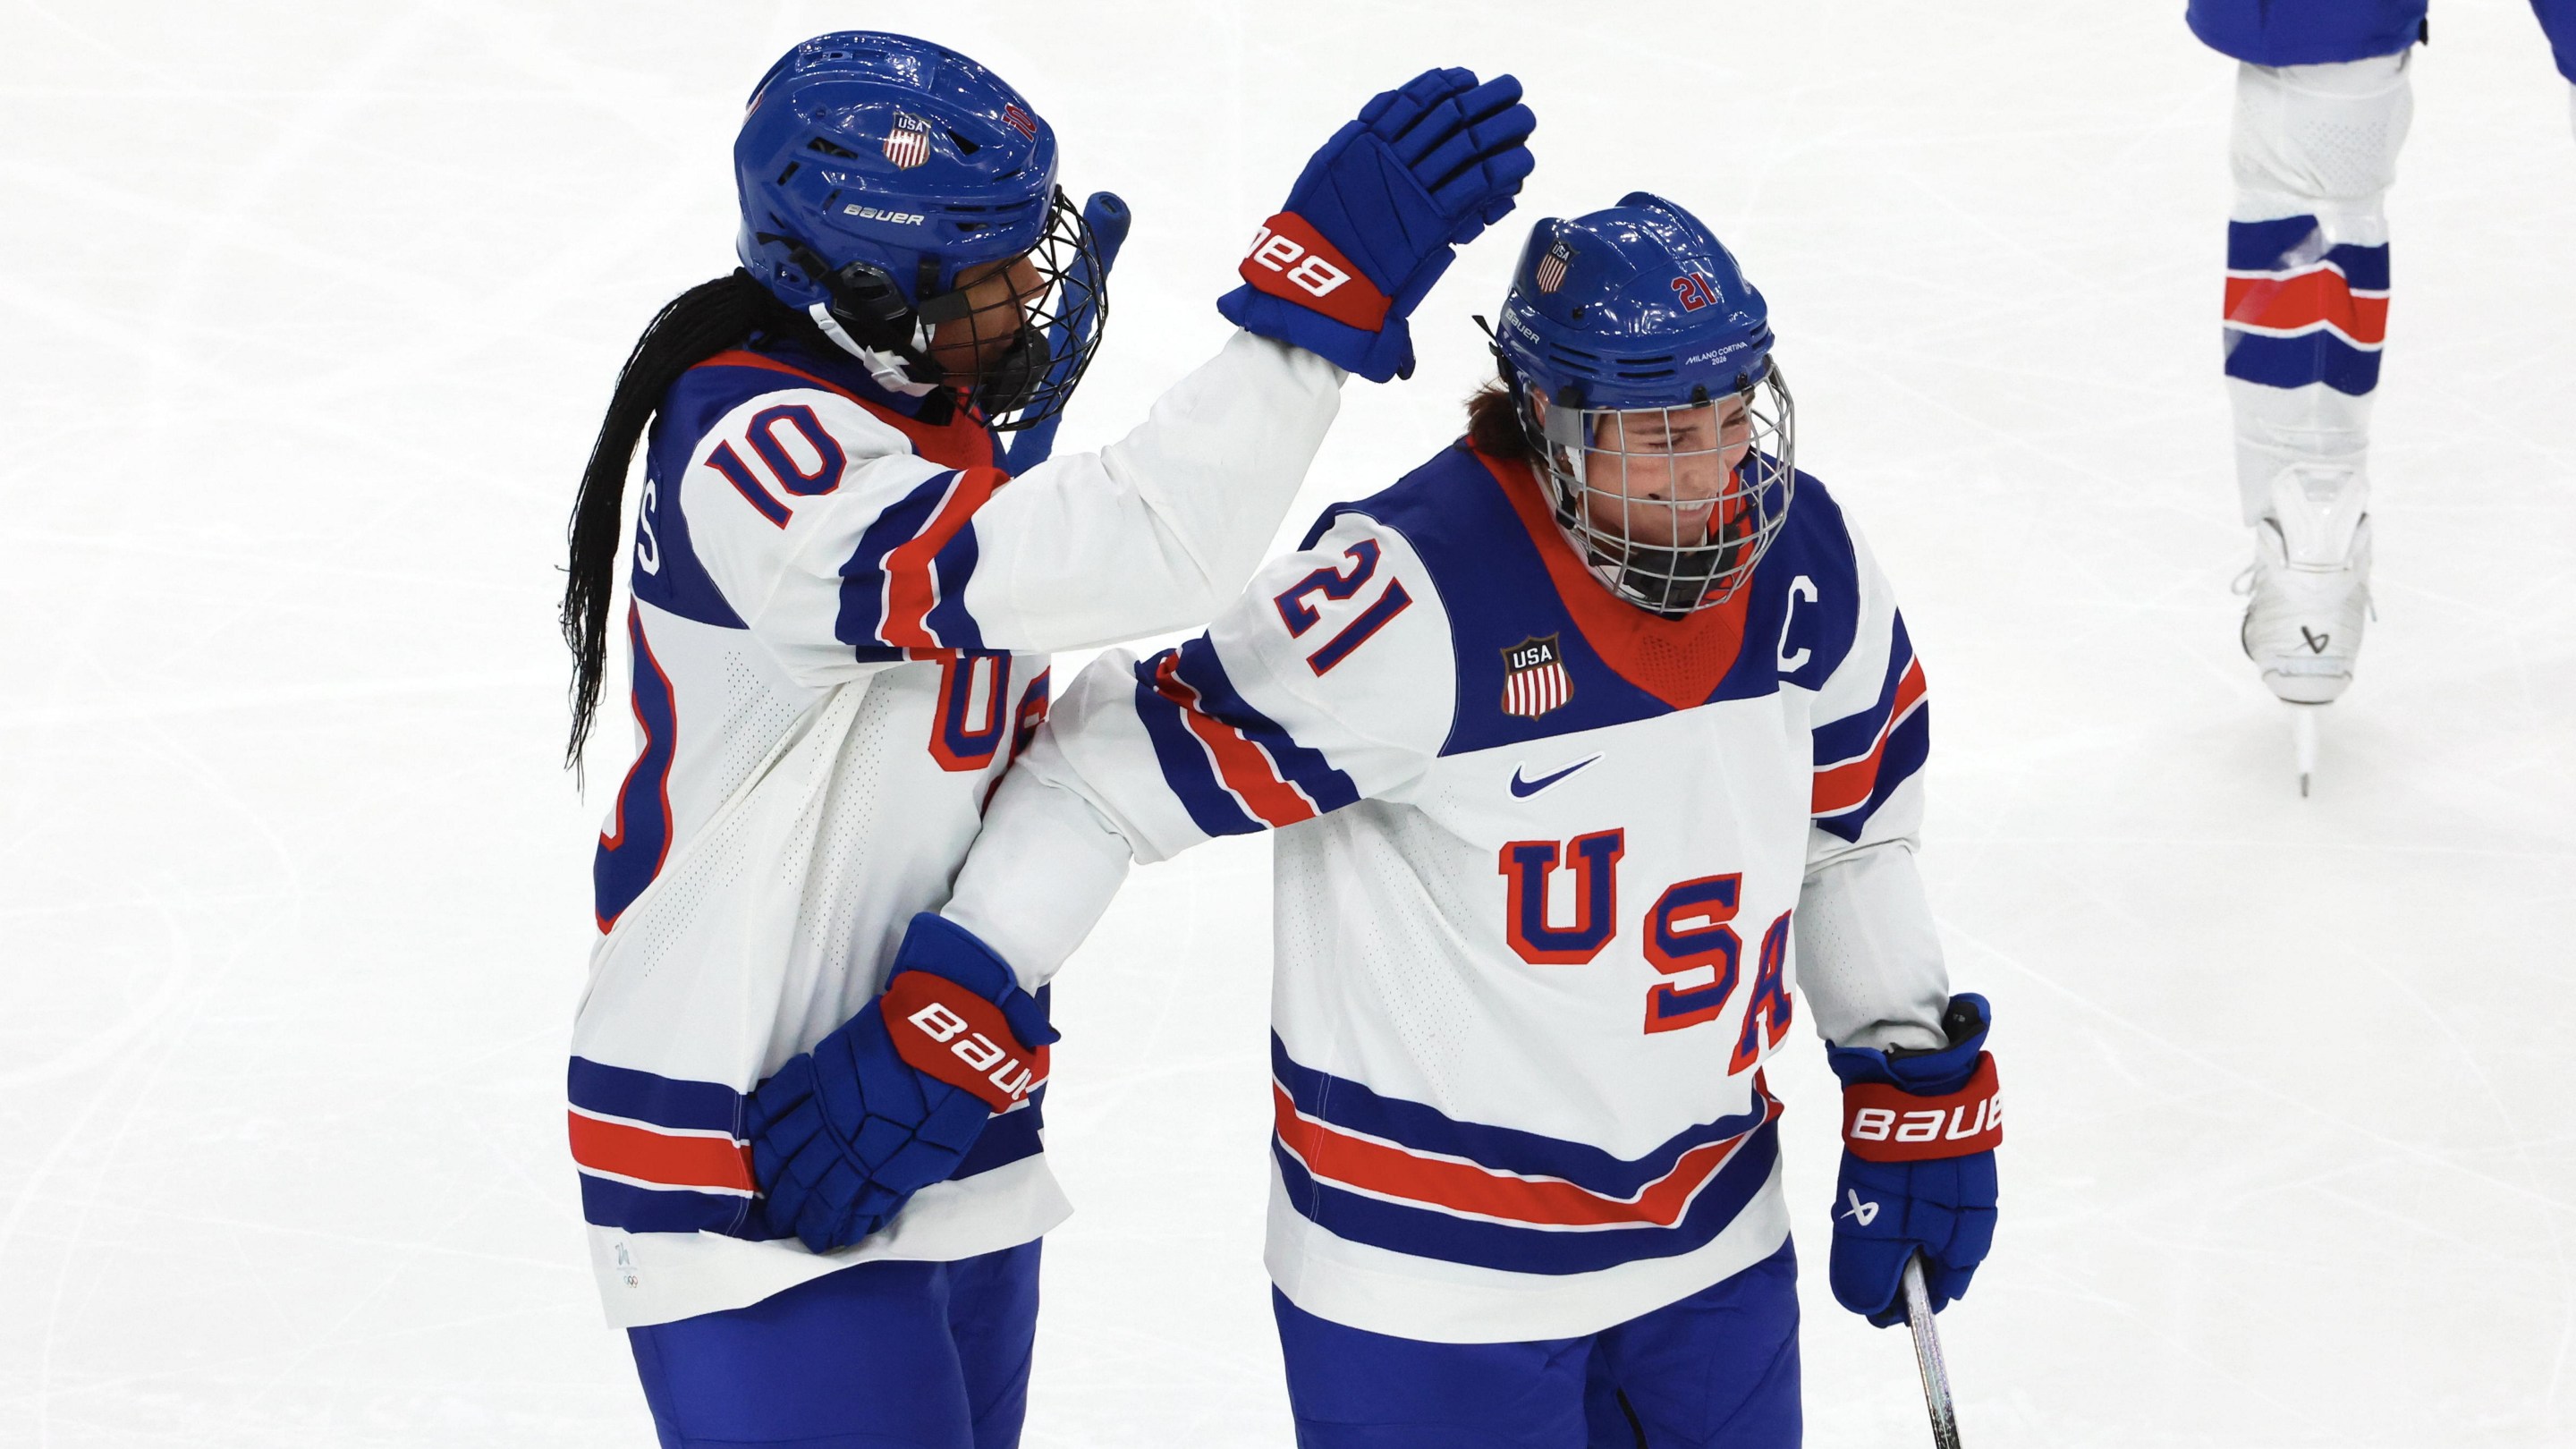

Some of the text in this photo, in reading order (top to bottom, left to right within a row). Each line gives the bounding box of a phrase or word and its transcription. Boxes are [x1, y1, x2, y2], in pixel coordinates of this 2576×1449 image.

[898, 117, 924, 132] USA
[1000, 101, 1038, 143] 10
[1552, 243, 1571, 261] USA
[1670, 271, 1719, 313] 21
[1684, 341, 1749, 366] MILANO CORTINA
[1711, 355, 1728, 366] 2026
[703, 403, 847, 530] 10
[1273, 538, 1413, 678] 21
[1777, 574, 1819, 674] C
[1512, 643, 1553, 670] USA
[1498, 826, 1792, 1077] USA
